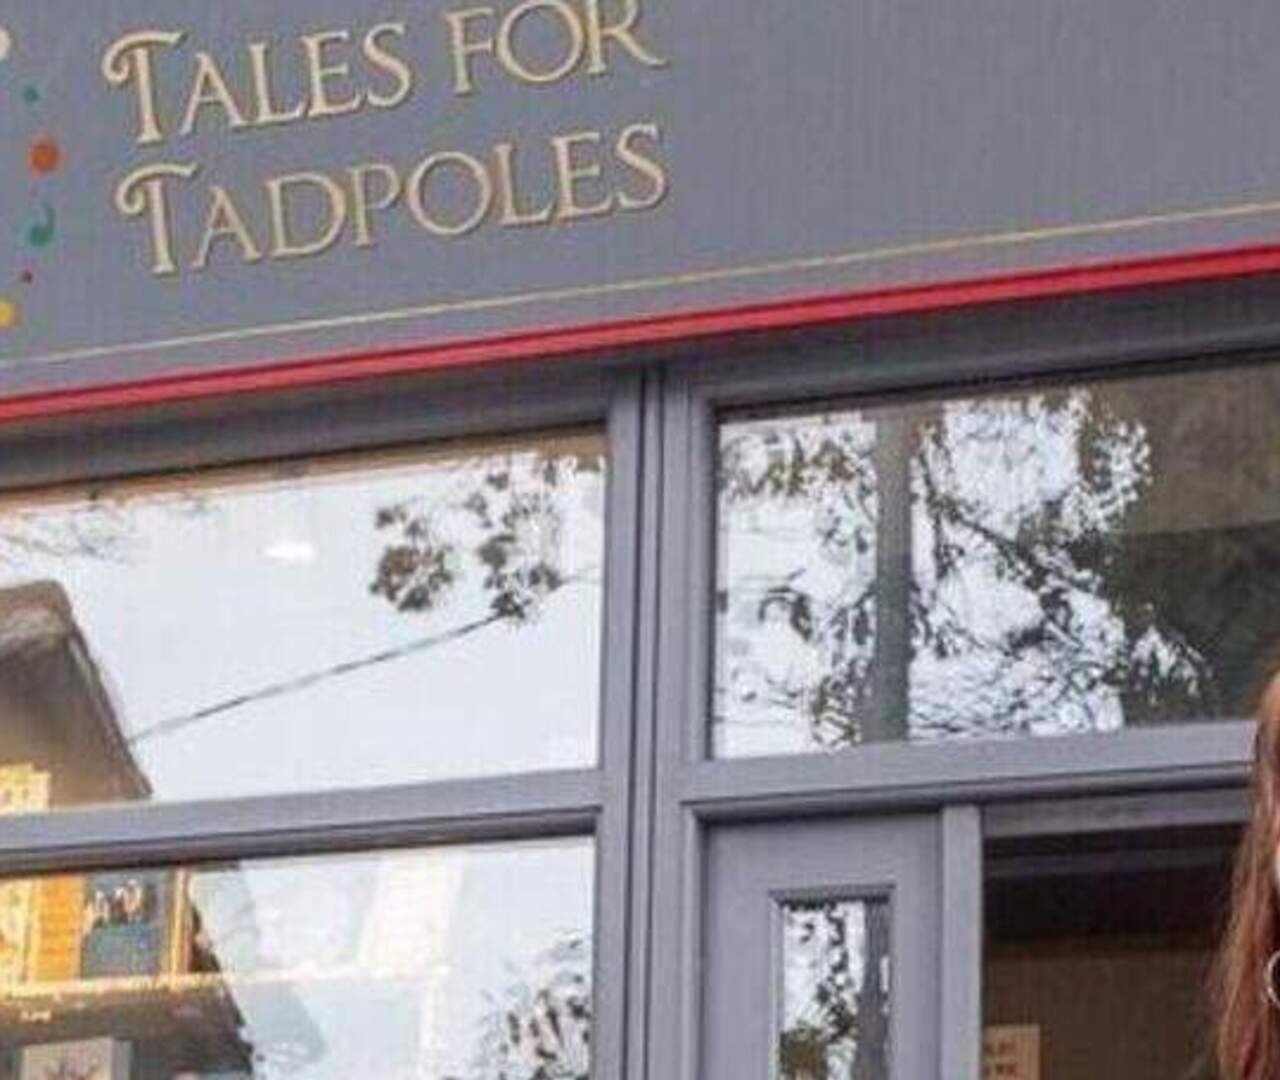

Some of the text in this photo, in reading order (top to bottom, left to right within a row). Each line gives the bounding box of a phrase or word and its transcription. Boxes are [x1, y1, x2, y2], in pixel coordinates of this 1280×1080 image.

[101, 0, 669, 144] TALES FOR
[116, 123, 666, 275] TADPOLES
